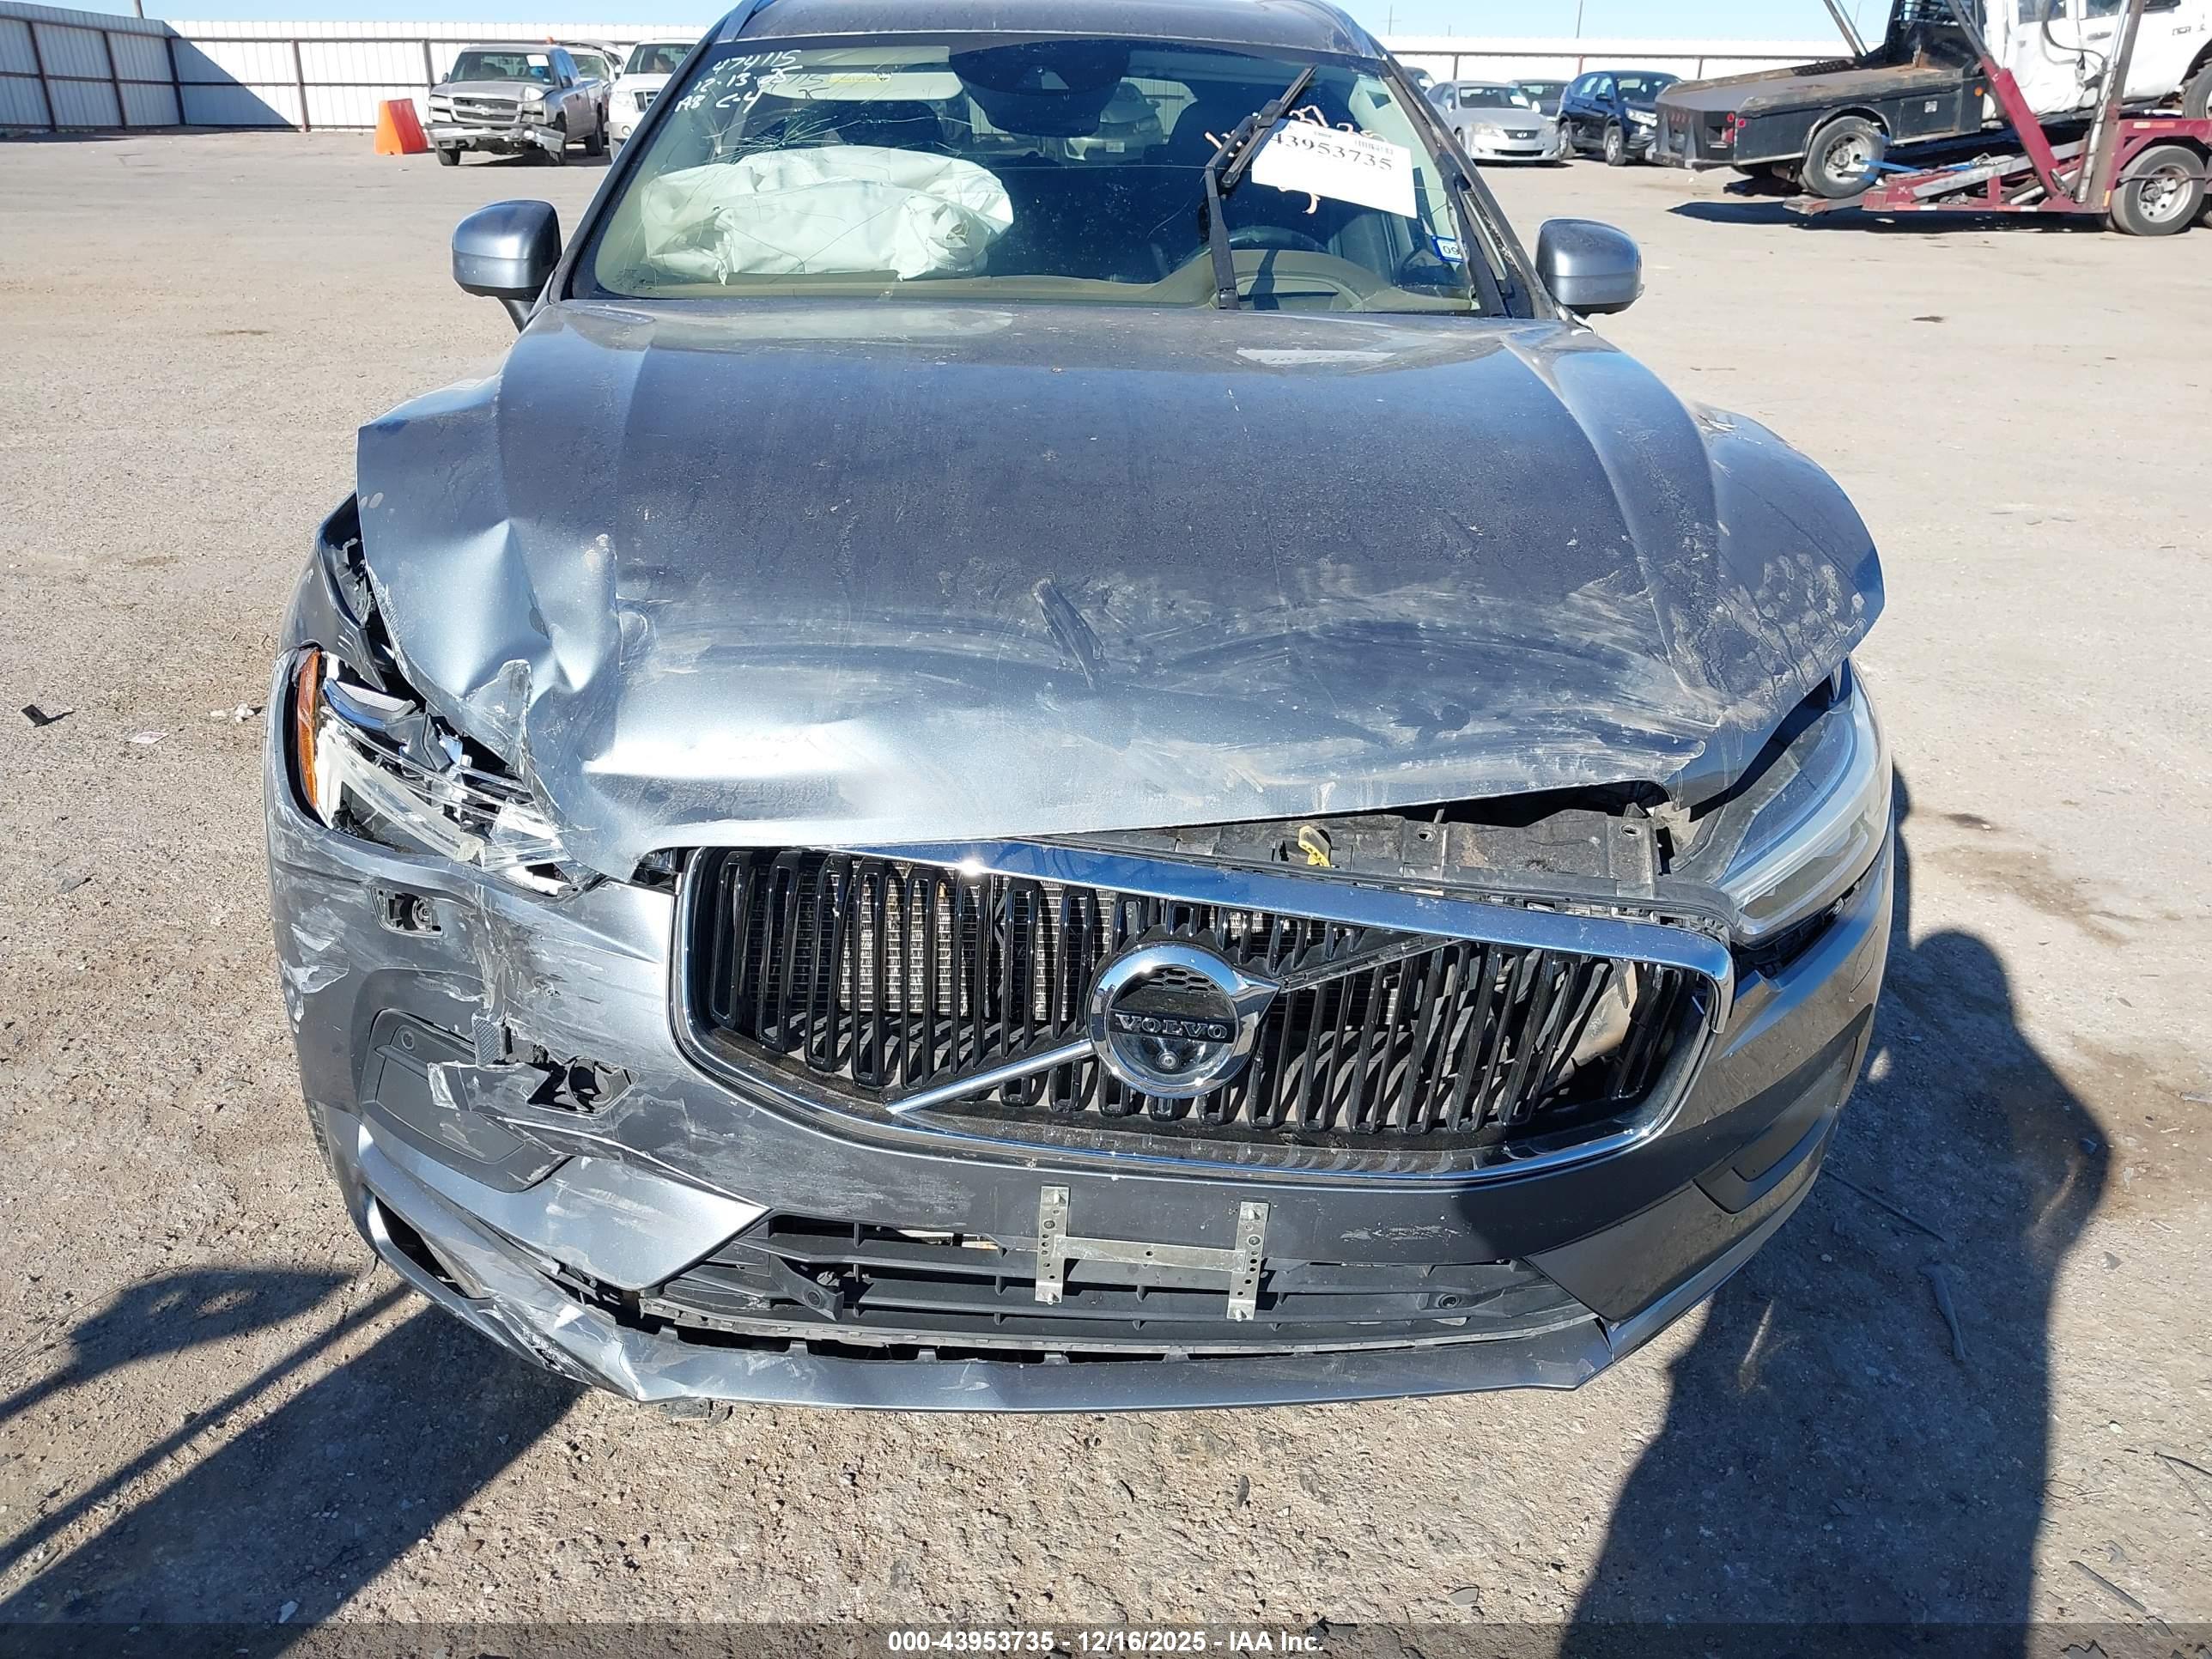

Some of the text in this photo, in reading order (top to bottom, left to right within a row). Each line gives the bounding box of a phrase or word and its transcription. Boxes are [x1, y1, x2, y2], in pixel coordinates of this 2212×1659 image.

[712, 50, 802, 76] 474115
[1271, 133, 1393, 171] 43953735
[1115, 1013, 1228, 1039] VOLVO
